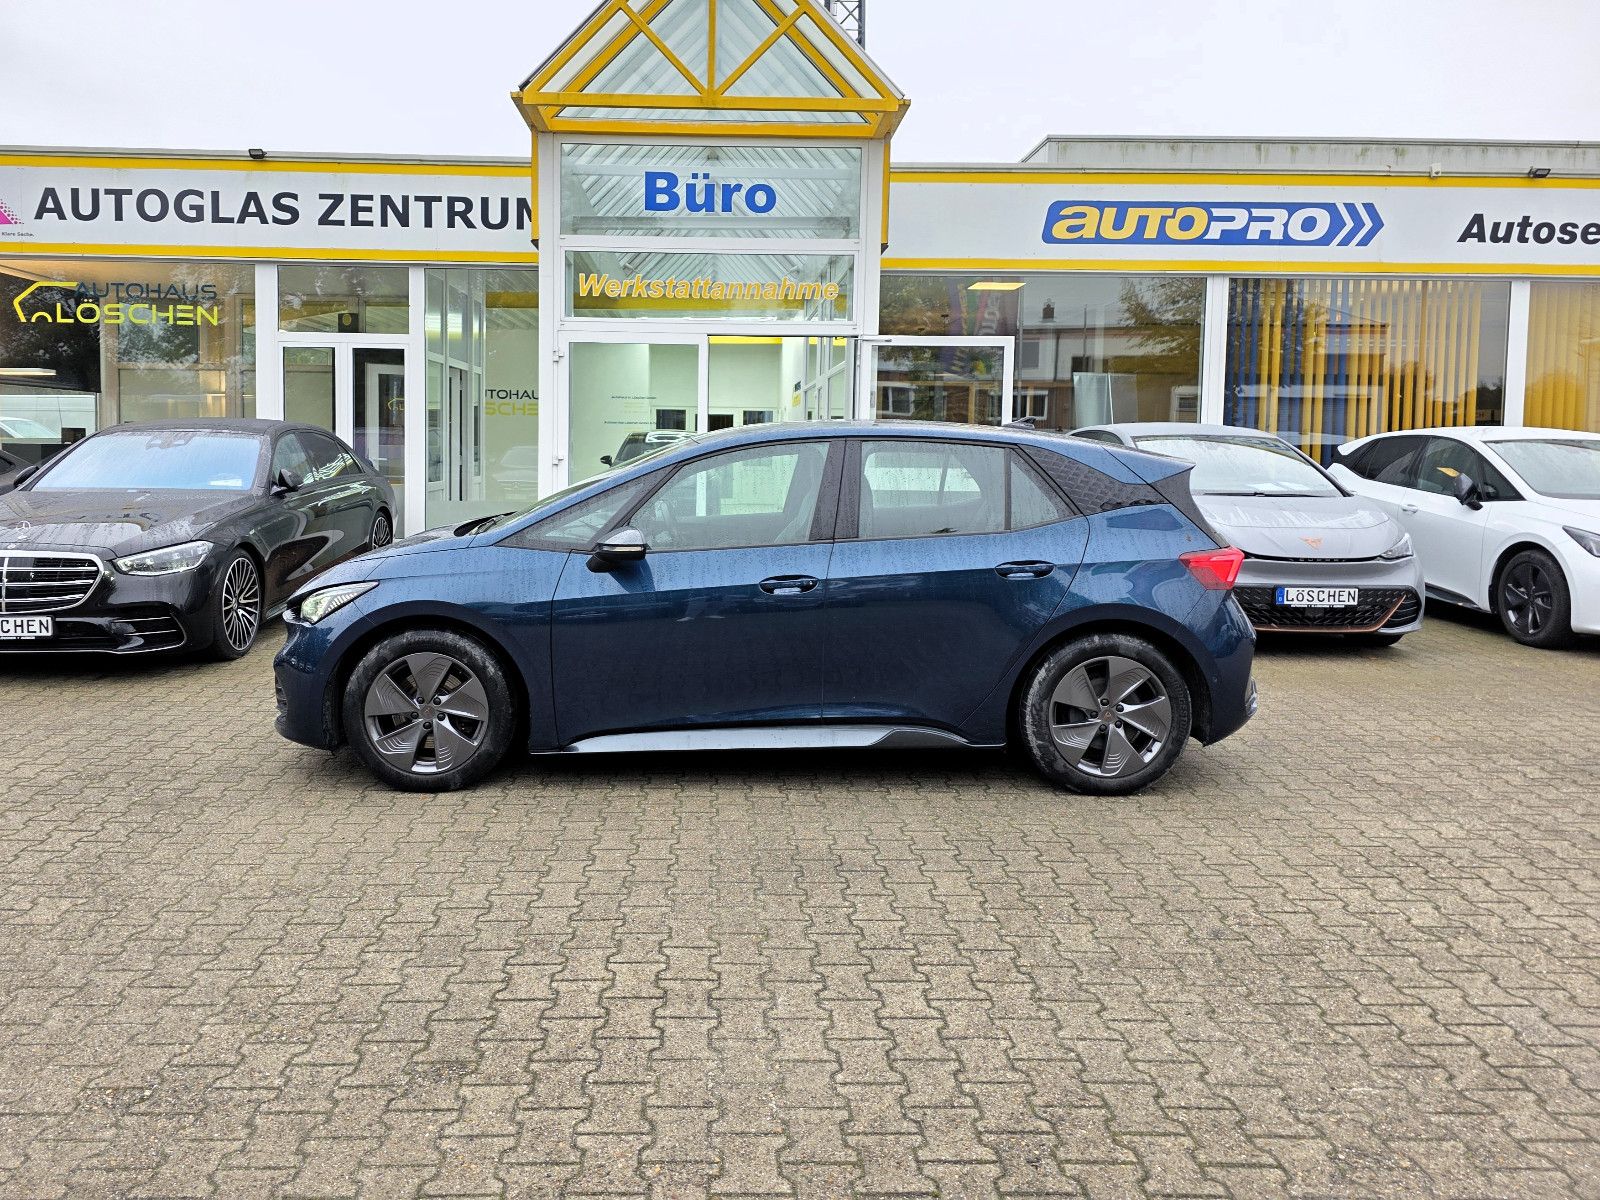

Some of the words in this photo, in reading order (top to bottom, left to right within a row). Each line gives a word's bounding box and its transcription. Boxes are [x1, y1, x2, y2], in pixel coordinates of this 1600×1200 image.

[34, 187, 300, 226] AUTOGLAS
[644, 171, 777, 214] Büro
[1456, 213, 1600, 245] Autose
[75, 282, 218, 300] AUTOHAUS
[578, 272, 841, 300] Werkstattannahme
[56, 298, 218, 326] LÖSCHEN
